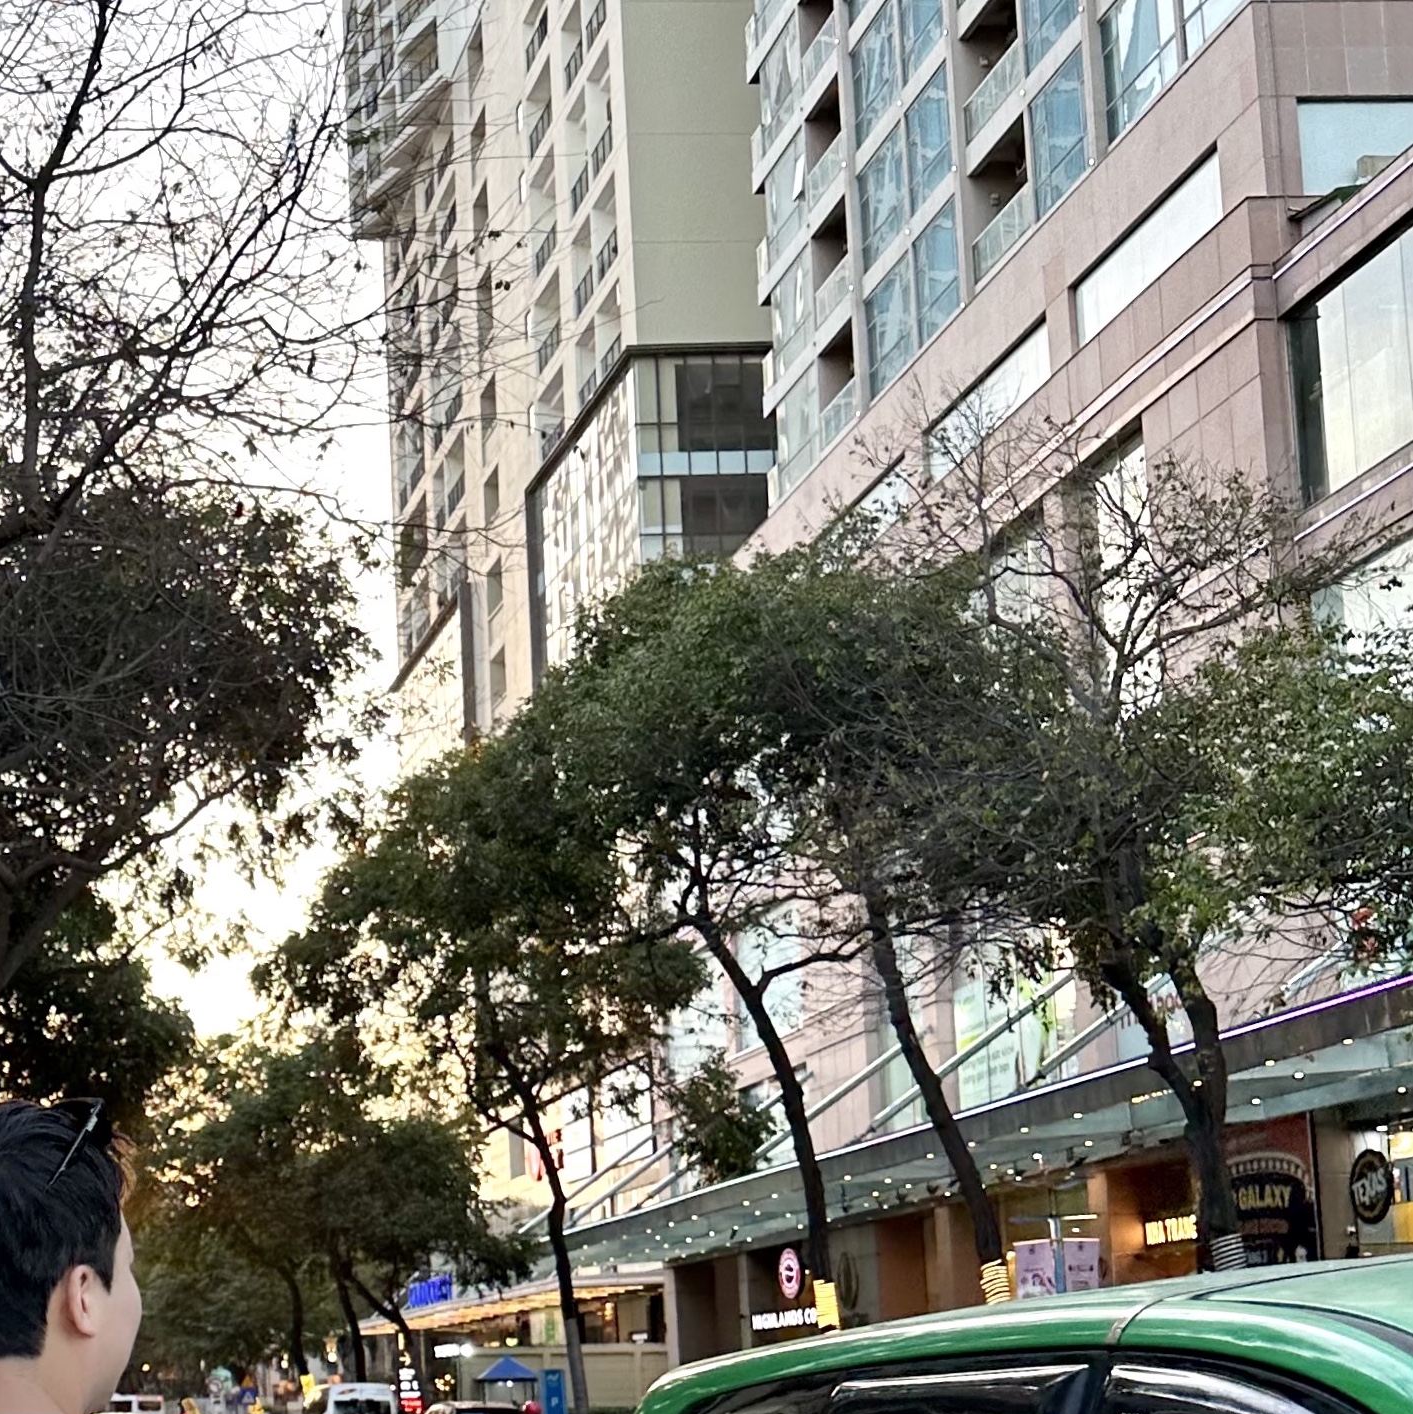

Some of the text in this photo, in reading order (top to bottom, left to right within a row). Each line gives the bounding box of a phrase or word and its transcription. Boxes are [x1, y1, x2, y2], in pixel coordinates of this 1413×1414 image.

[1239, 1184, 1292, 1211] GALAXY
[1351, 1167, 1388, 1207] TEXAS
[751, 1307, 804, 1331] HIGHLANDS
